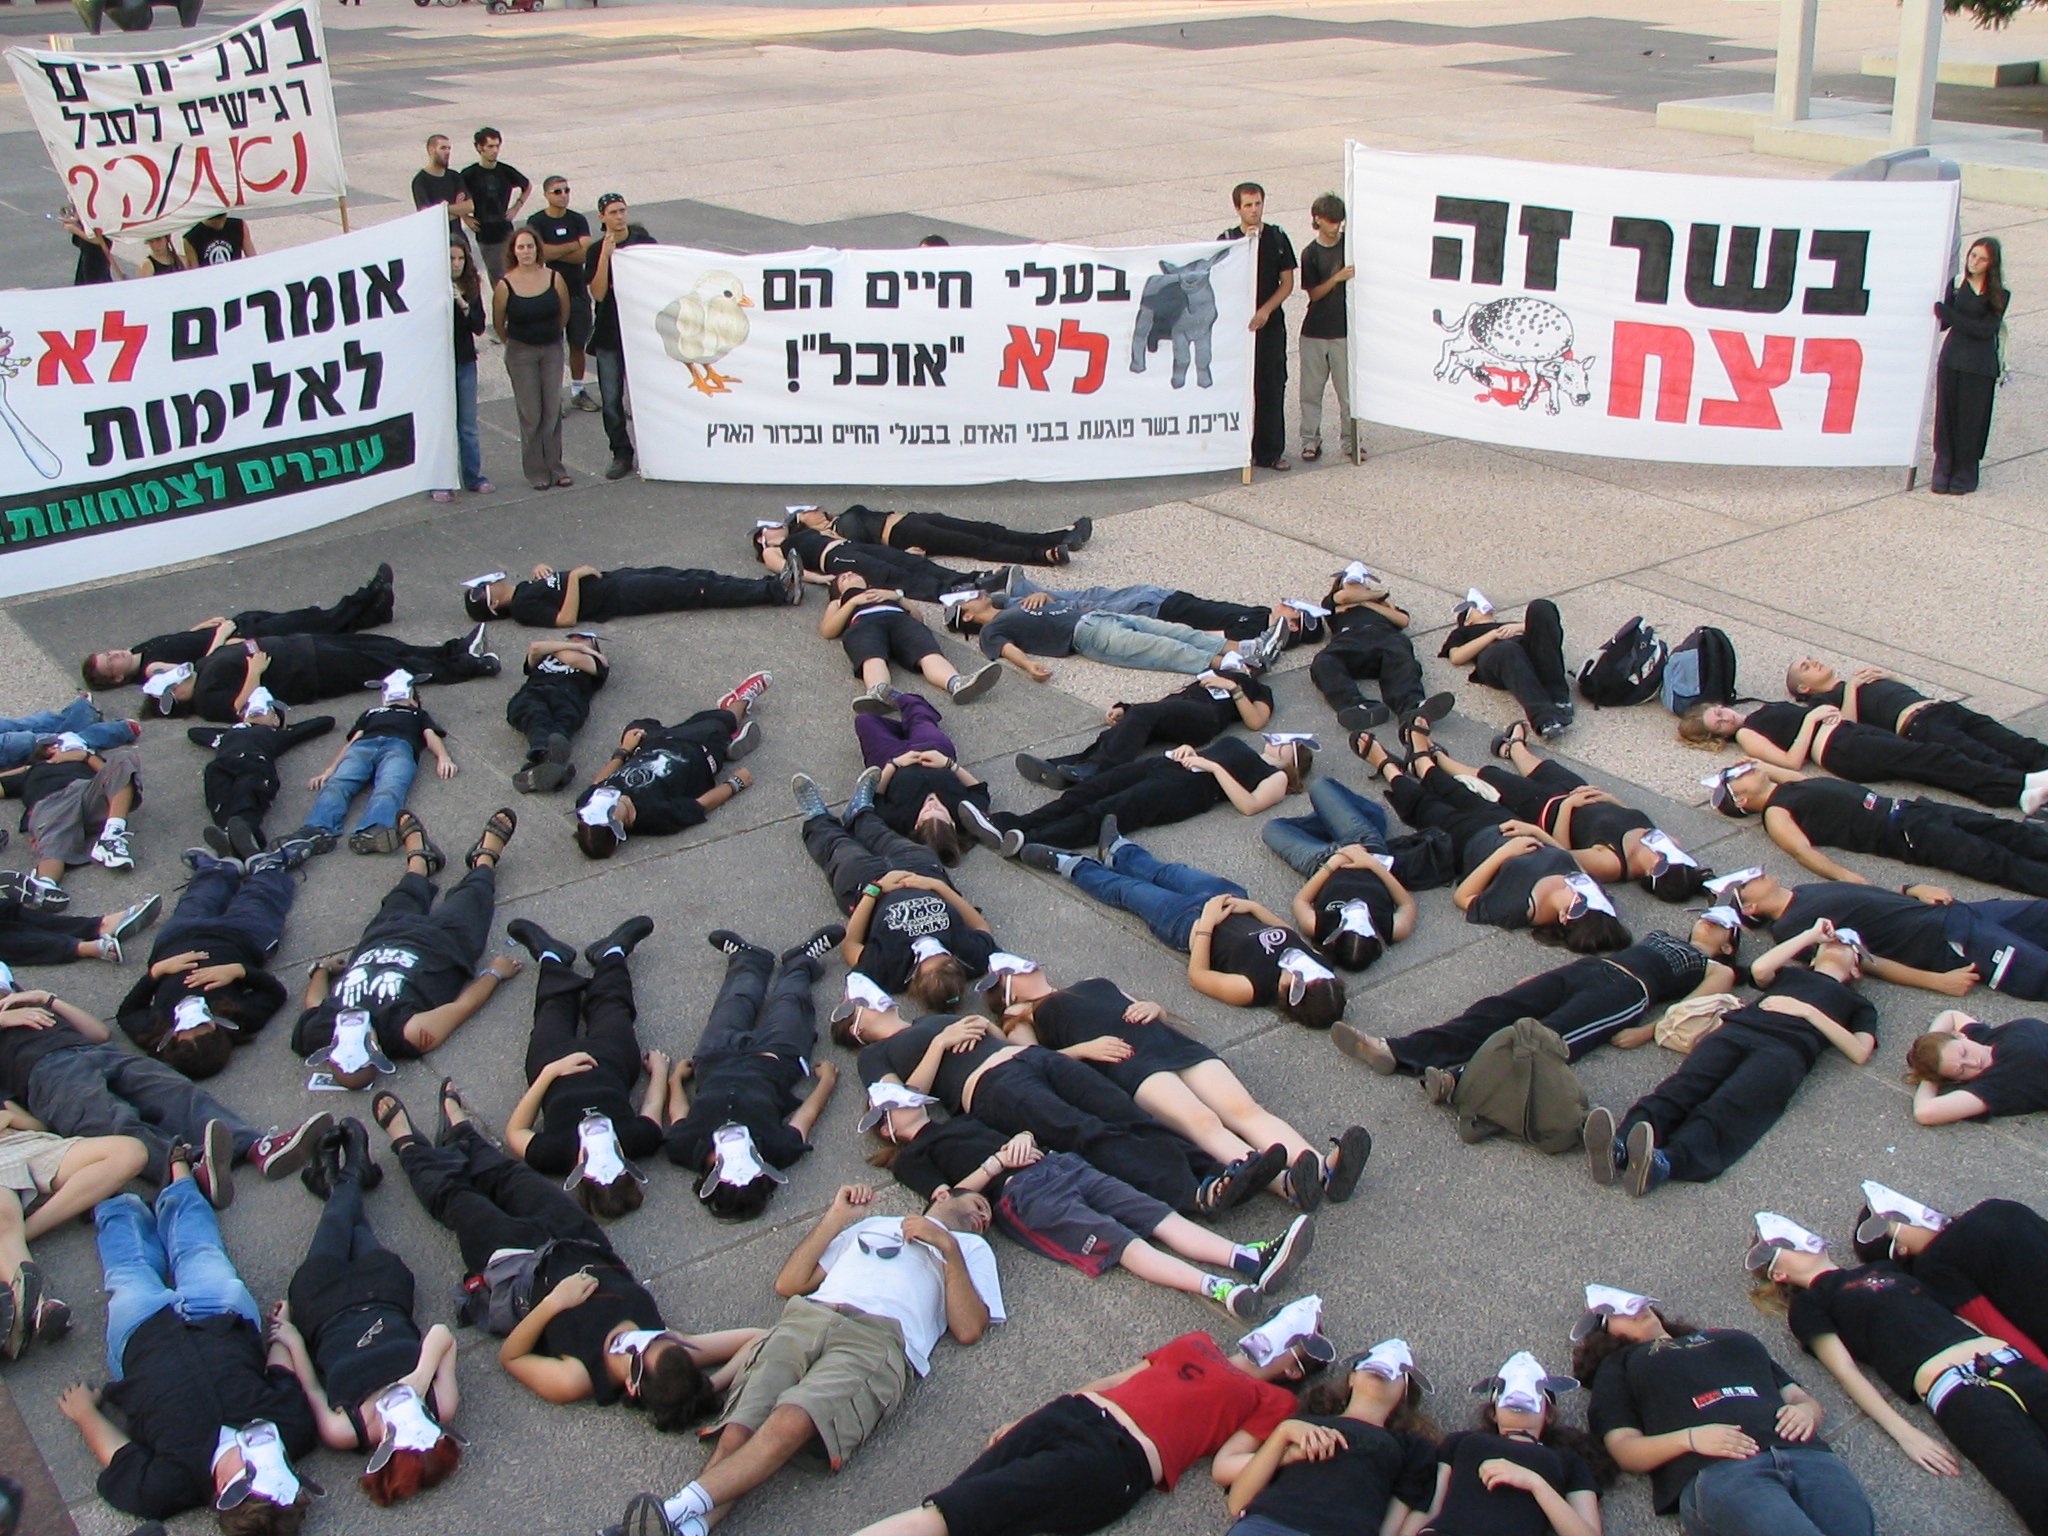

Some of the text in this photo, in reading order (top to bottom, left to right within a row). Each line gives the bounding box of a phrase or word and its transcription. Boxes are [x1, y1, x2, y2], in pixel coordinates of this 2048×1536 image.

[61, 80, 313, 150] רגישים לסבל
[1430, 194, 1871, 316] בשר זה
[763, 262, 1131, 311] בעלי חיים הם
[36, 258, 410, 386] אומרים לא
[998, 318, 1110, 395] לא
[1606, 319, 1863, 434] רצח
[84, 340, 384, 467] לאלימות
[707, 423, 754, 447] הארץ
[763, 424, 823, 444] ובכדור
[832, 424, 880, 444] החיים
[889, 423, 951, 444] בבעלי
[1026, 421, 1069, 442] בבני
[1077, 418, 1135, 440] פוגעת
[1141, 416, 1180, 436] בשר
[1186, 411, 1240, 435] צריכת
[236, 434, 385, 494] עוברים
